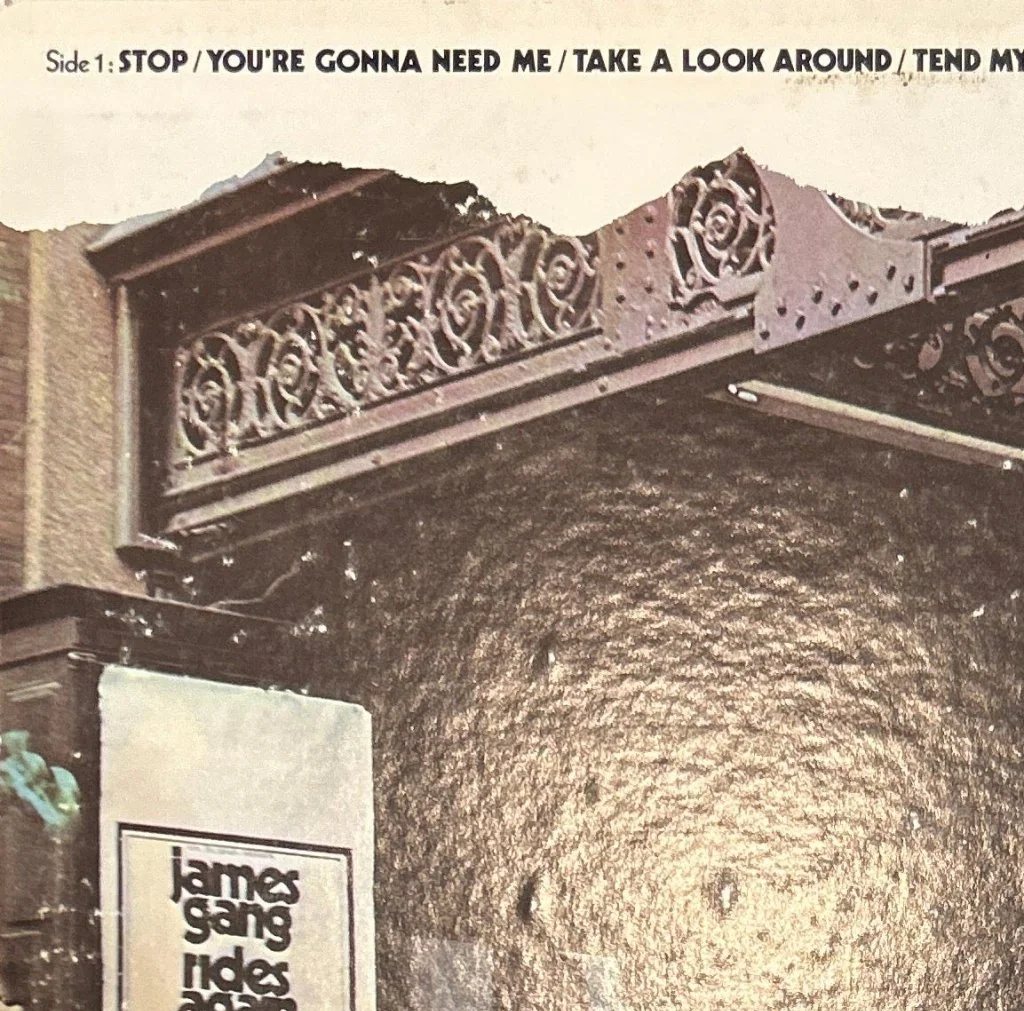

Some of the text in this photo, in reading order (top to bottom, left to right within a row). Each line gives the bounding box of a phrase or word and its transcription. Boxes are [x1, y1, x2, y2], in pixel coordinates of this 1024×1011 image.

[47, 50, 90, 73] Side
[119, 49, 188, 73] STOP
[207, 49, 305, 73] YOU'RE
[315, 49, 422, 73] GONNA
[432, 49, 500, 73] NEED
[512, 49, 551, 73] ME
[573, 49, 641, 73] TAKE
[651, 49, 673, 73] A
[683, 48, 765, 73] LOOK
[773, 48, 891, 73] AROUND
[913, 48, 980, 73] TEND
[171, 846, 300, 904] james
[183, 897, 292, 952] gang
[184, 946, 290, 997] rides
